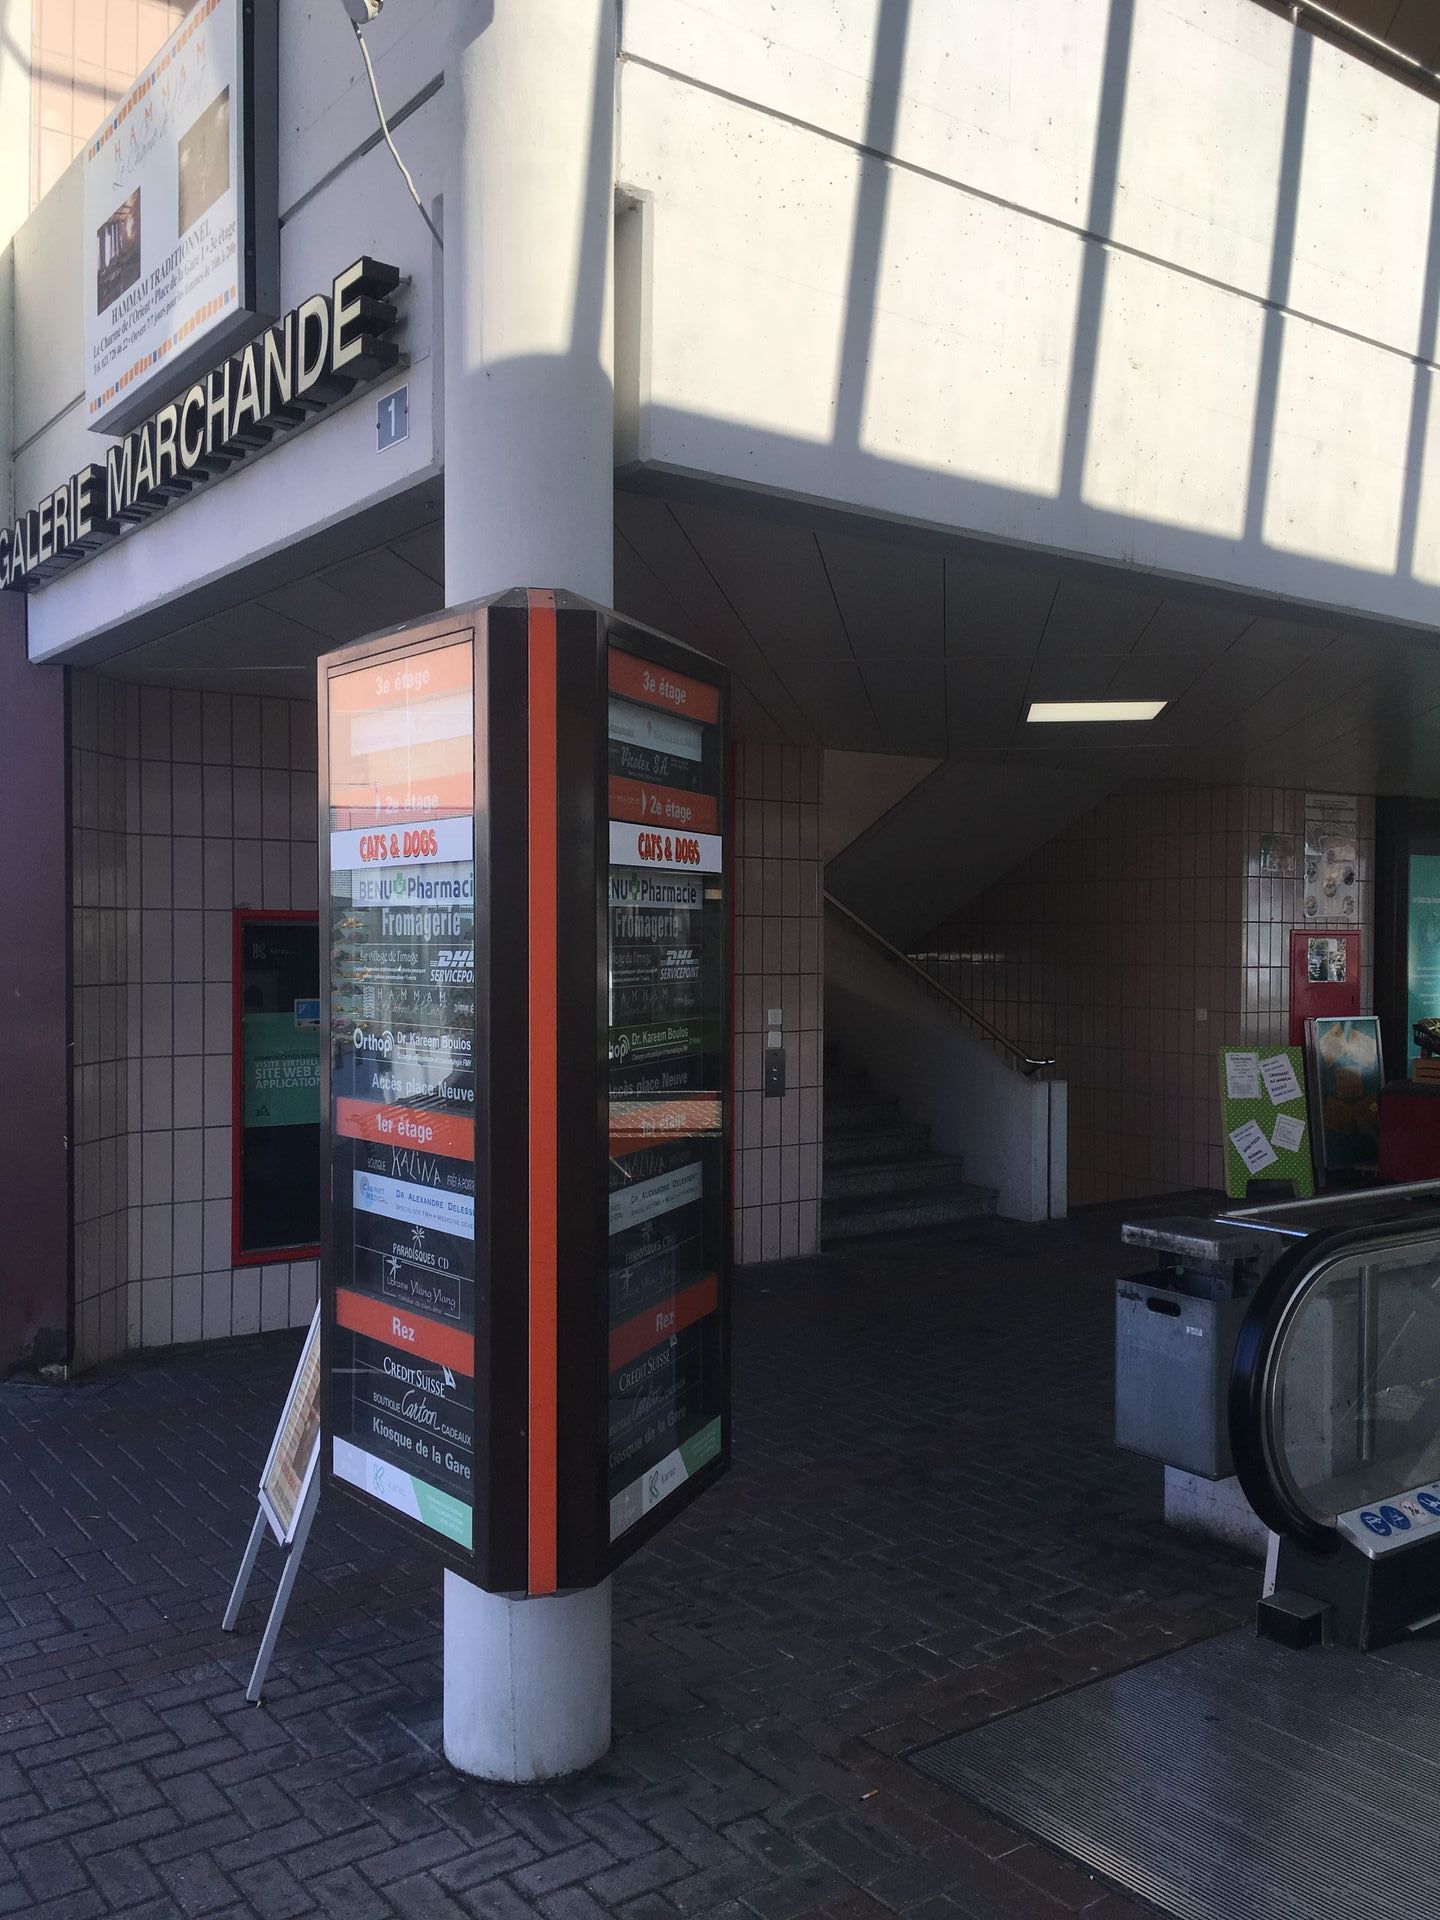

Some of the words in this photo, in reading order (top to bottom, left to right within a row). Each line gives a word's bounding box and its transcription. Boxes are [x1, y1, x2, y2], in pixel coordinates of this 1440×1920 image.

[111, 280, 149, 326] HAMMAM
[149, 218, 211, 293] TRADITIONNEL
[93, 344, 101, 359] Le
[100, 326, 121, 352] Charme
[121, 320, 129, 334] de
[128, 302, 151, 330] l'Orient
[154, 284, 170, 306] Place
[184, 257, 200, 281] Gare
[130, 324, 147, 347] Ouvert
[153, 307, 166, 328] jours
[166, 295, 178, 317] pour
[0, 465, 92, 588] GALERIE
[107, 259, 364, 521] MARCHANDE
[387, 397, 397, 438] 1
[375, 674, 391, 697] 3e
[394, 668, 430, 692] étage
[642, 670, 656, 693] 3e
[659, 678, 687, 706] étage
[385, 795, 399, 814] 2e
[403, 791, 439, 815] étage
[650, 795, 662, 816] 2e
[665, 798, 693, 823] étage
[359, 833, 388, 862] CATS
[390, 832, 400, 858] &
[403, 828, 438, 857] DOGS
[638, 832, 663, 861] CATS
[665, 836, 673, 861] &
[675, 837, 700, 865] DOGS
[359, 879, 392, 900] BENU
[609, 878, 628, 900] NU
[641, 877, 697, 904] Pharmacie
[382, 908, 461, 942] Fromagerie
[615, 908, 679, 943] Fromagerie
[368, 950, 388, 965] village
[388, 950, 396, 962] de
[666, 949, 695, 966] DHL
[660, 966, 700, 981] SERVICEPOINT
[377, 988, 447, 1004] HAMMAM
[397, 1031, 408, 1045] Dr.
[410, 1032, 440, 1048] Kareem
[441, 1035, 472, 1051] Boulos
[631, 1032, 642, 1046] Dr.
[642, 1029, 667, 1045] Kareem
[667, 1026, 688, 1040] Boulos
[255, 1060, 281, 1069] VISITE
[255, 1067, 281, 1080] SITE
[283, 1066, 312, 1079] WEB
[371, 1072, 402, 1092] Accès
[406, 1077, 435, 1097] place
[438, 1081, 475, 1102] Neuve
[636, 1076, 660, 1096] place
[662, 1071, 688, 1089] Neuve
[376, 1113, 394, 1133] 1er
[398, 1118, 433, 1144] étage
[438, 1256, 449, 1270] CD
[409, 1279, 432, 1303] Ylang
[432, 1287, 456, 1312] Ylang
[392, 1315, 415, 1342] Rez
[655, 1311, 675, 1333] Rez
[383, 1356, 415, 1385] CREDIT
[416, 1369, 445, 1399] SUISSE
[618, 1365, 648, 1392] CREDIT
[647, 1348, 672, 1375] SUISSE
[372, 1391, 401, 1414] BOUTIQUE
[401, 1388, 441, 1431] Cartoon
[441, 1423, 472, 1447] CADEAUX
[644, 1426, 656, 1445] de
[657, 1418, 666, 1436] la
[667, 1405, 687, 1427] Gare
[372, 1416, 413, 1450] Kiosque
[415, 1439, 429, 1458] de
[431, 1445, 442, 1465] la
[444, 1452, 472, 1480] Gare
